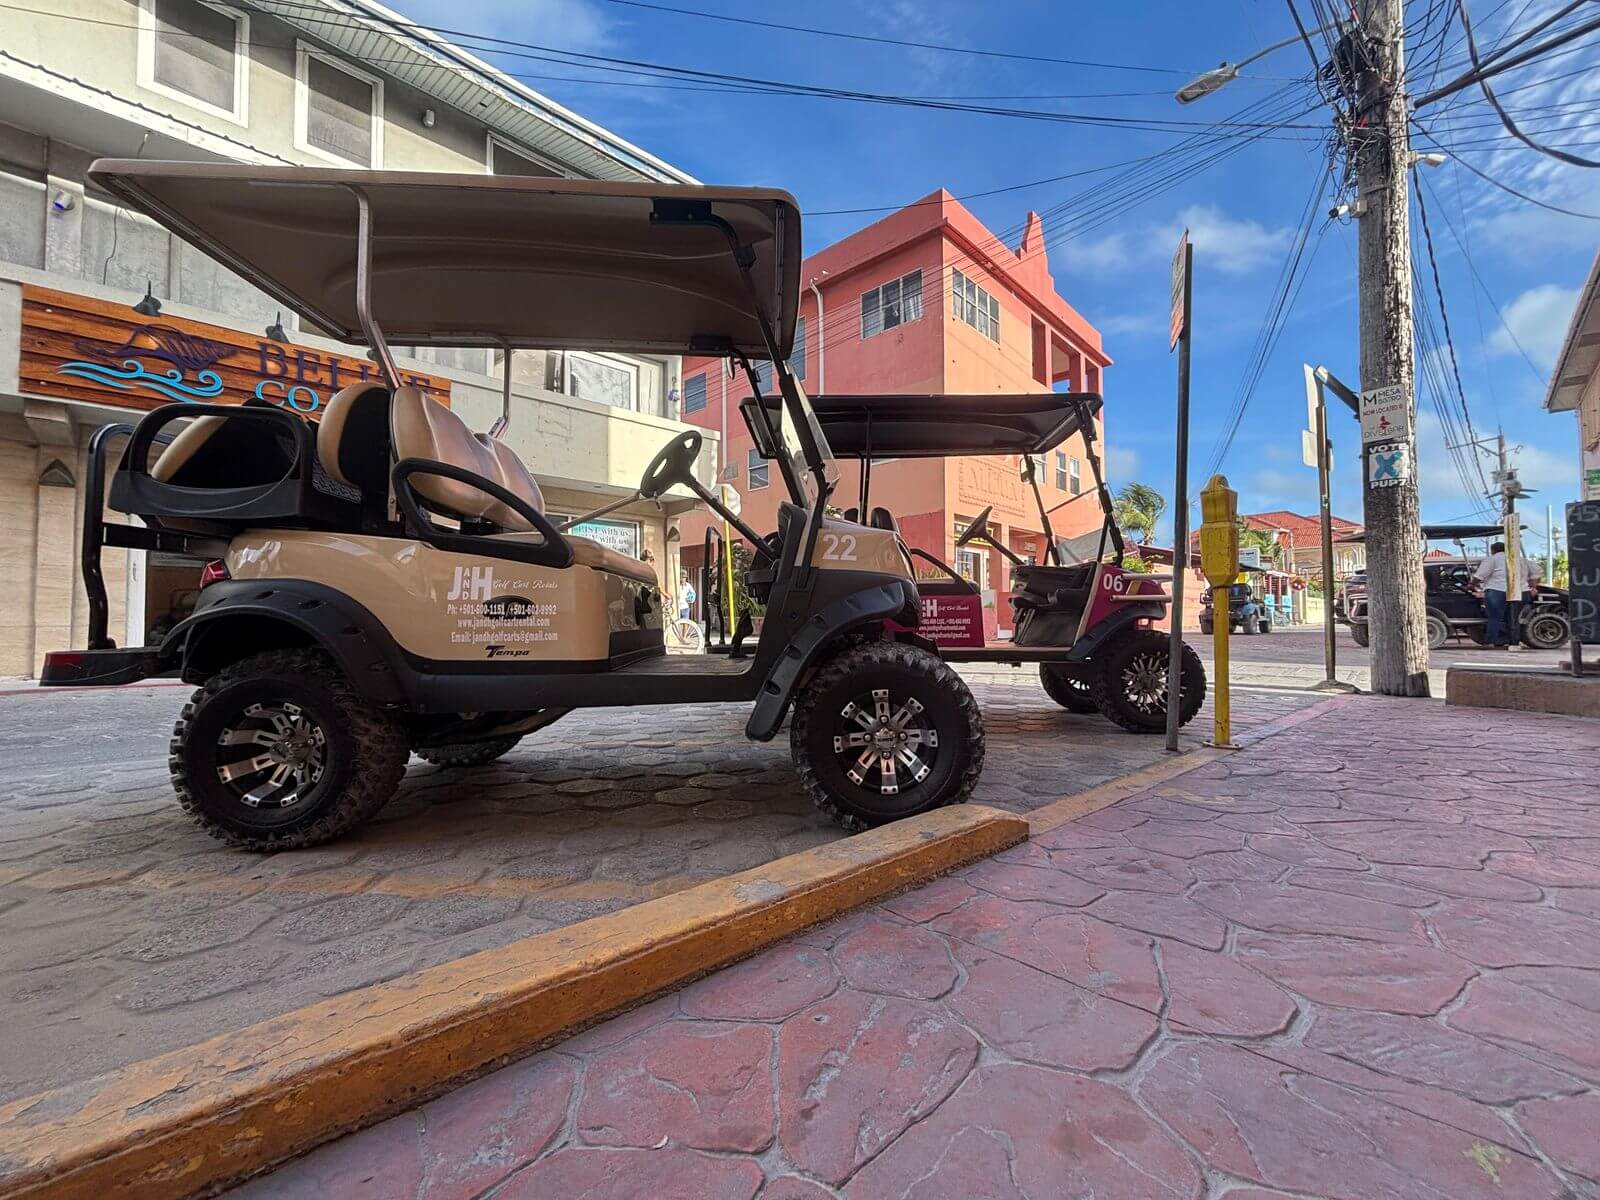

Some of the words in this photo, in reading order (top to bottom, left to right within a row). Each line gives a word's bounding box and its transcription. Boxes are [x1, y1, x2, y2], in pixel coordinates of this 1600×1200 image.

[1378, 388, 1401, 398] MESA
[1376, 404, 1397, 414] LOCATED
[1369, 443, 1409, 454] VOTE
[600, 536, 616, 544] with
[822, 534, 857, 561] 22
[1103, 573, 1123, 592] 06
[485, 645, 531, 658] Tempo
